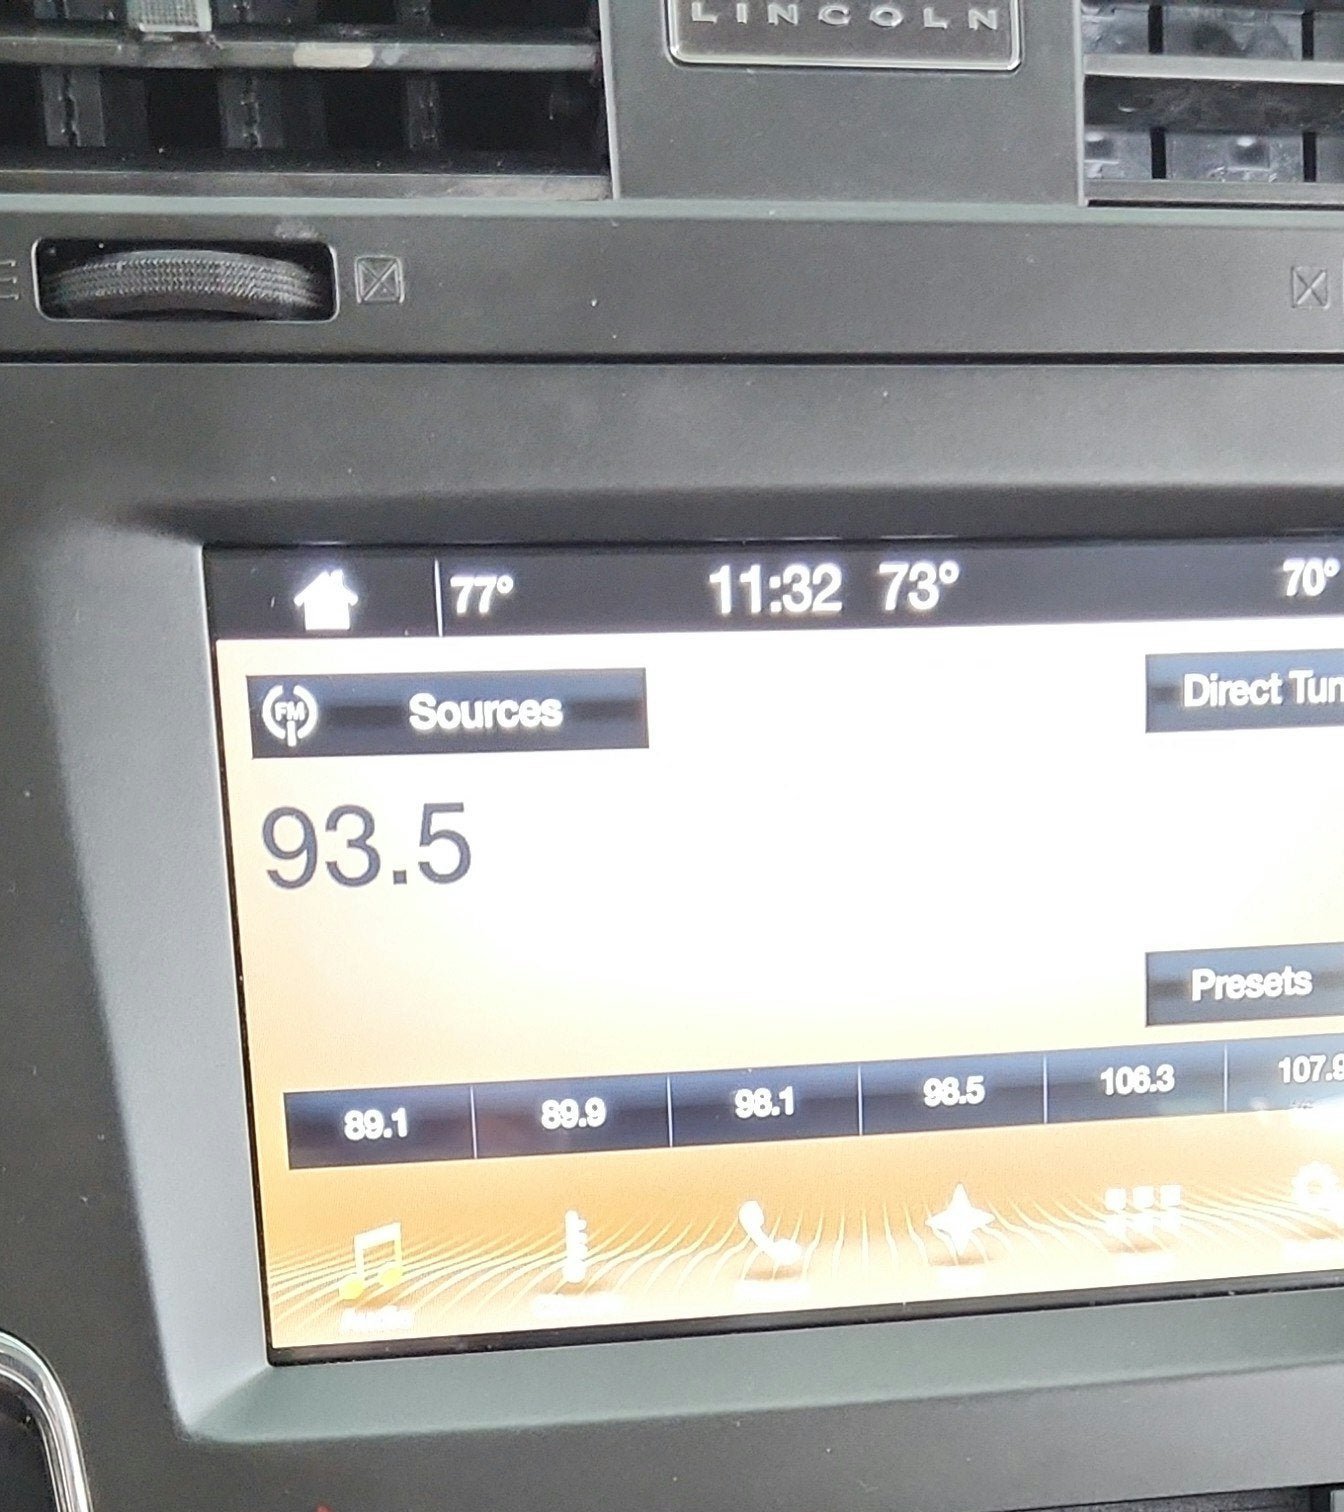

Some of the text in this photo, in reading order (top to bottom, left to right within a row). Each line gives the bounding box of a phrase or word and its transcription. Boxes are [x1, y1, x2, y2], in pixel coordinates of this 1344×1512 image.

[691, 1, 999, 31] LINCOLN
[709, 563, 844, 615] 11:32
[1183, 671, 1283, 709] Direct
[408, 692, 564, 730] Sources
[261, 801, 473, 890] 93.5
[1191, 965, 1314, 1003] Presets
[923, 1075, 986, 1108] 98.5
[1099, 1064, 1176, 1097] 106.3
[343, 1107, 409, 1141] 89.1
[540, 1097, 607, 1130] 89.9
